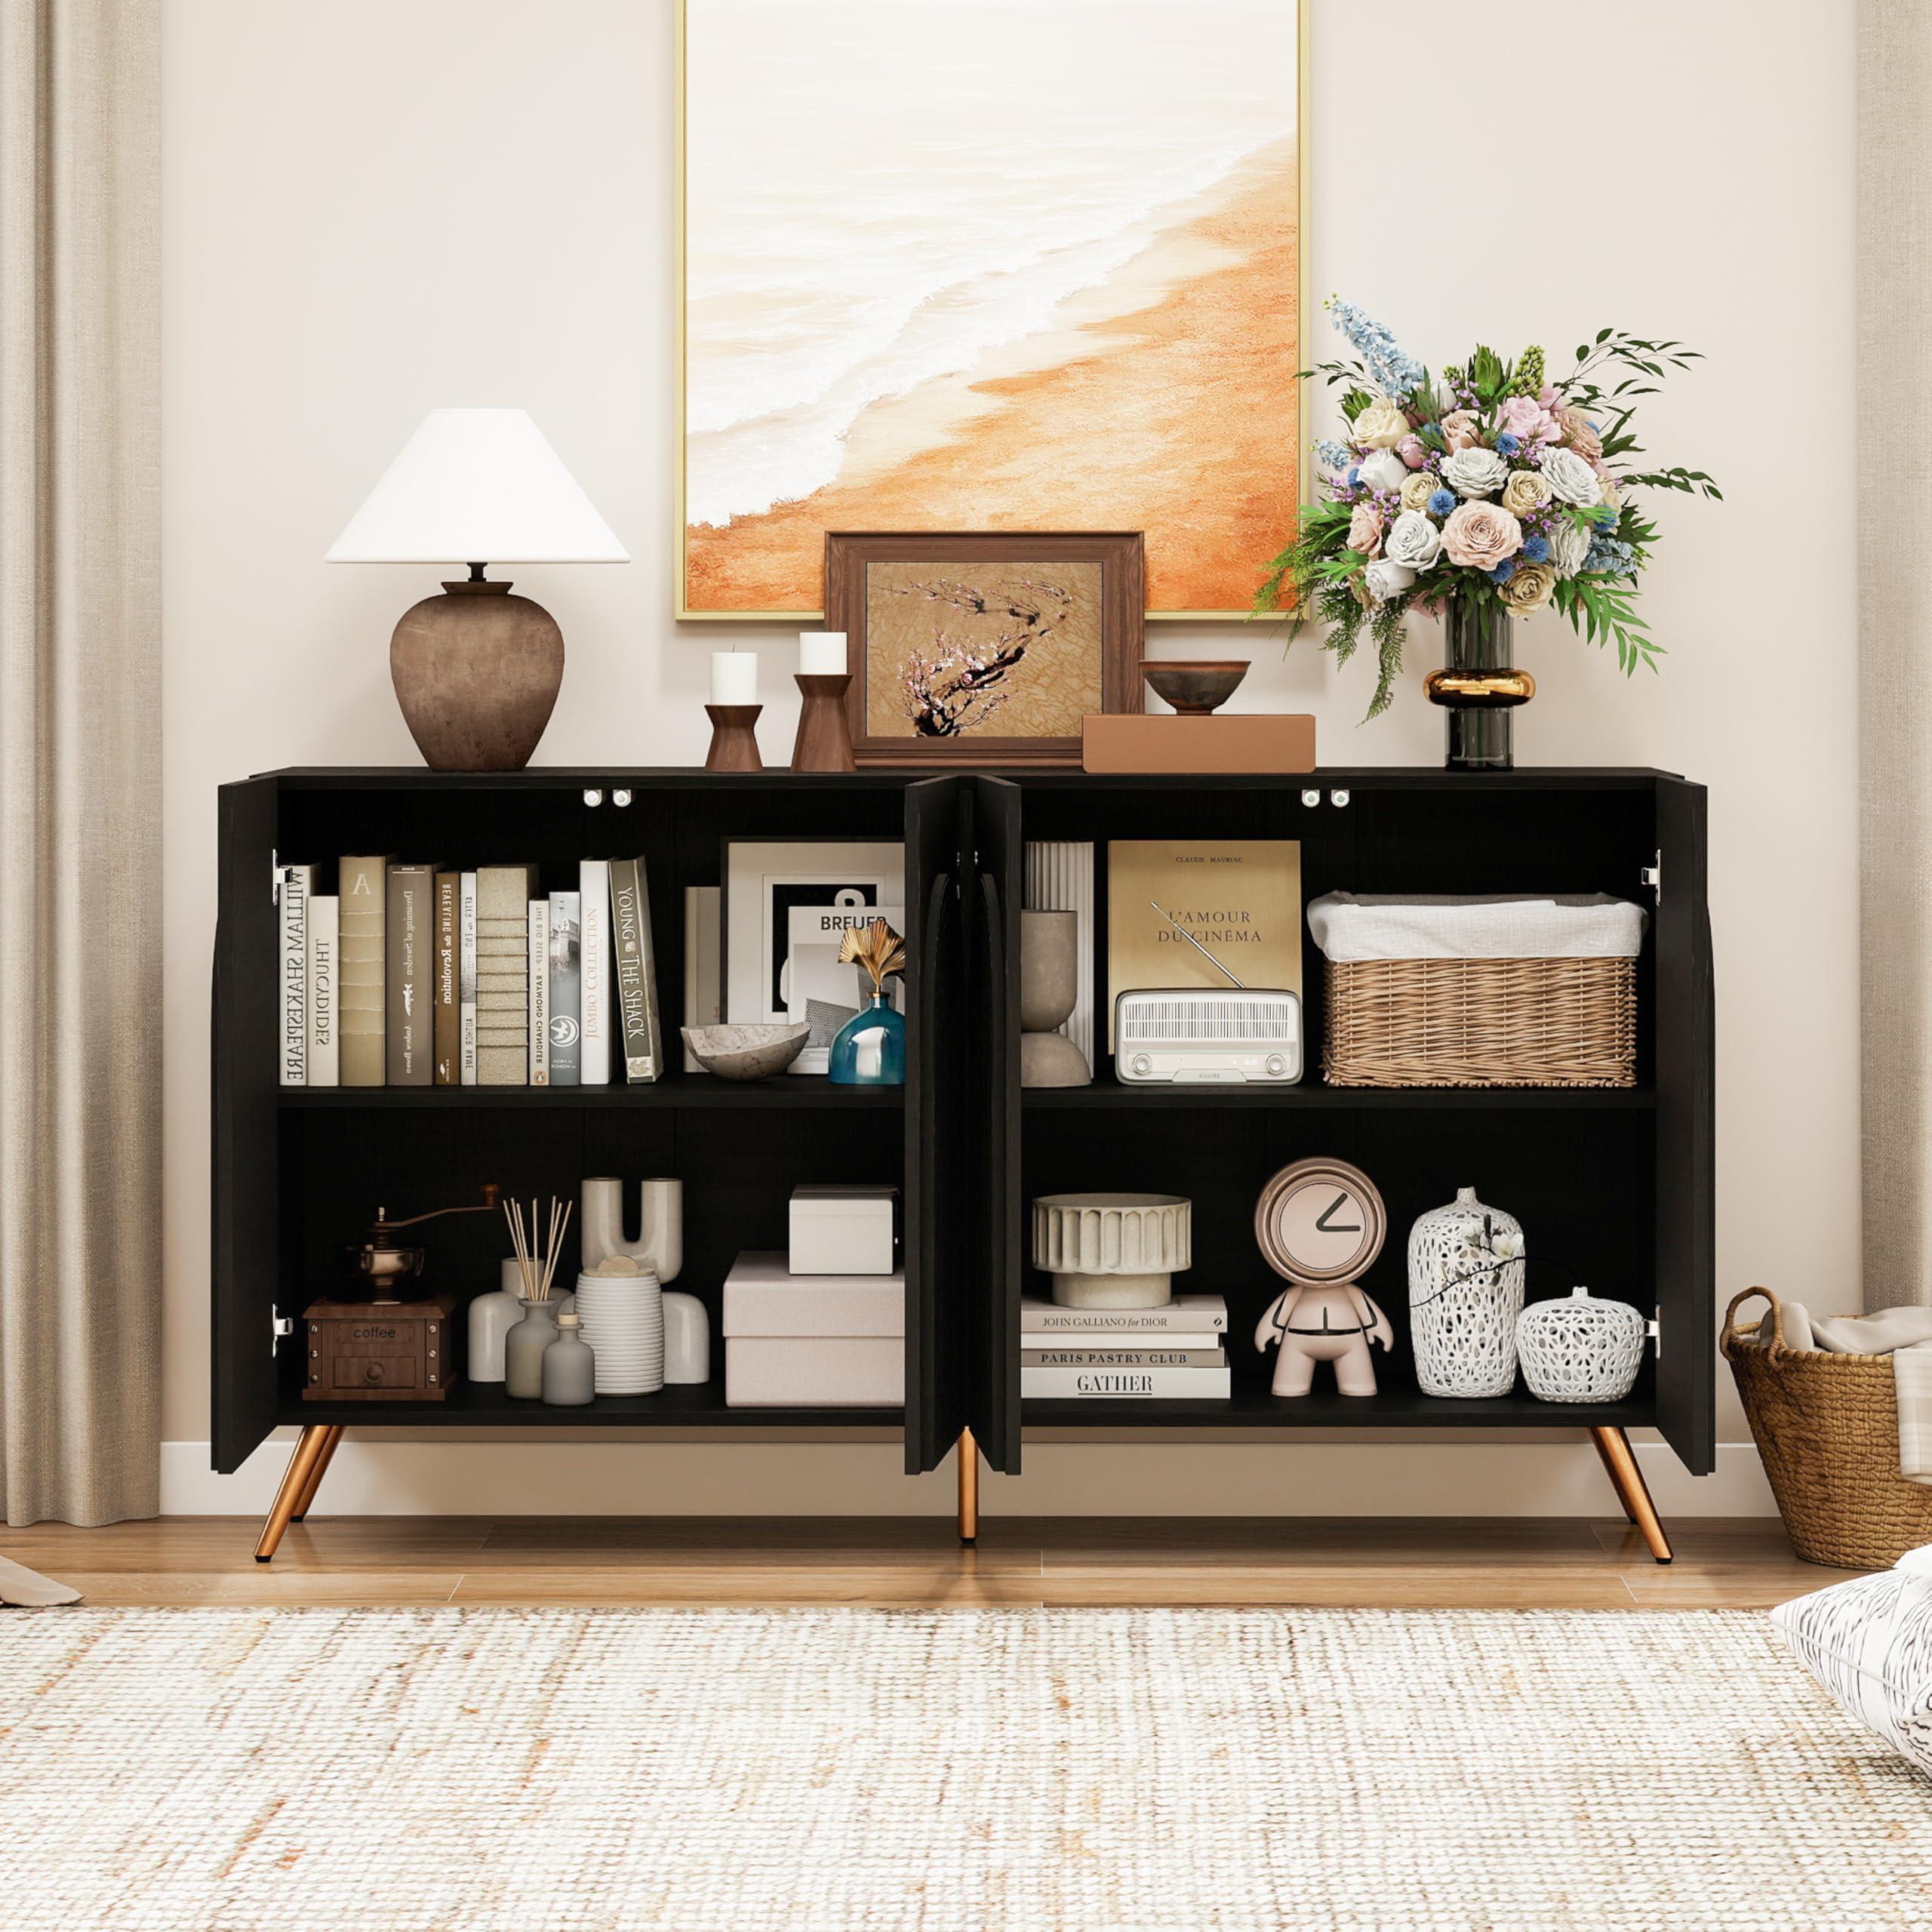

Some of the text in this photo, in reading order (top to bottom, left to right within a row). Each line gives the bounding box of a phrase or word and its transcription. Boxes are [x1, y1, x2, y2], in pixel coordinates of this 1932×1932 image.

[351, 874, 371, 894] A
[1158, 929, 1262, 943] DU CINÉMA
[617, 886, 645, 1039] YOUNG THE SHACK
[1043, 1318, 1167, 1328] JOHN GALLIANO for DIOR
[354, 1327, 396, 1338] coffee
[1041, 1354, 1187, 1363] PARIS PASTRY CLUB
[1078, 1375, 1152, 1392] GATHER
